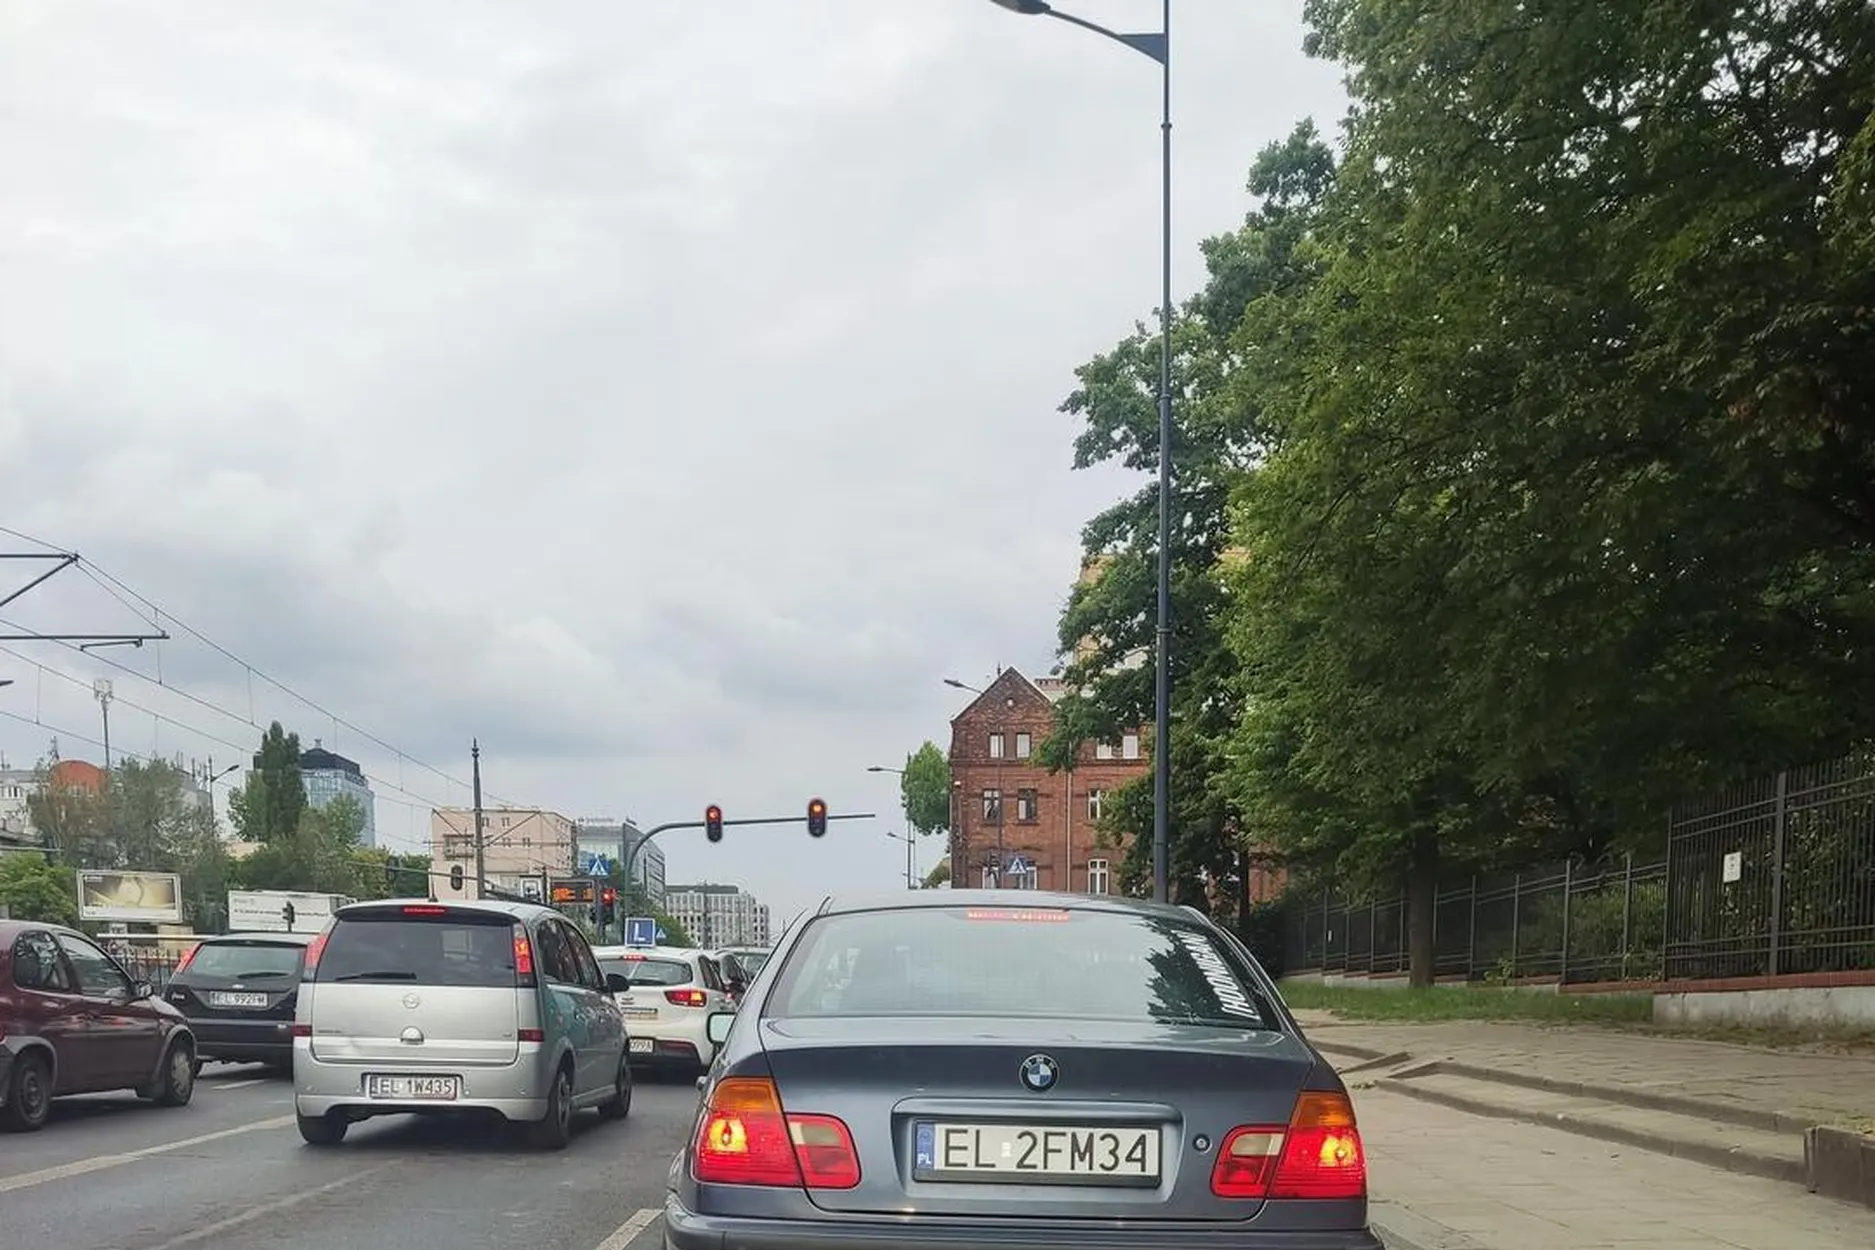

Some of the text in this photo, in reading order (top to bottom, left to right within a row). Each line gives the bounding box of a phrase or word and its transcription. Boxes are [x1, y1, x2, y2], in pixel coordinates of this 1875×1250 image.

[634, 922, 646, 942] L
[380, 1079, 452, 1095] EL 1W435
[917, 1153, 932, 1166] PL
[944, 1128, 1147, 1173] EL 2FM34
